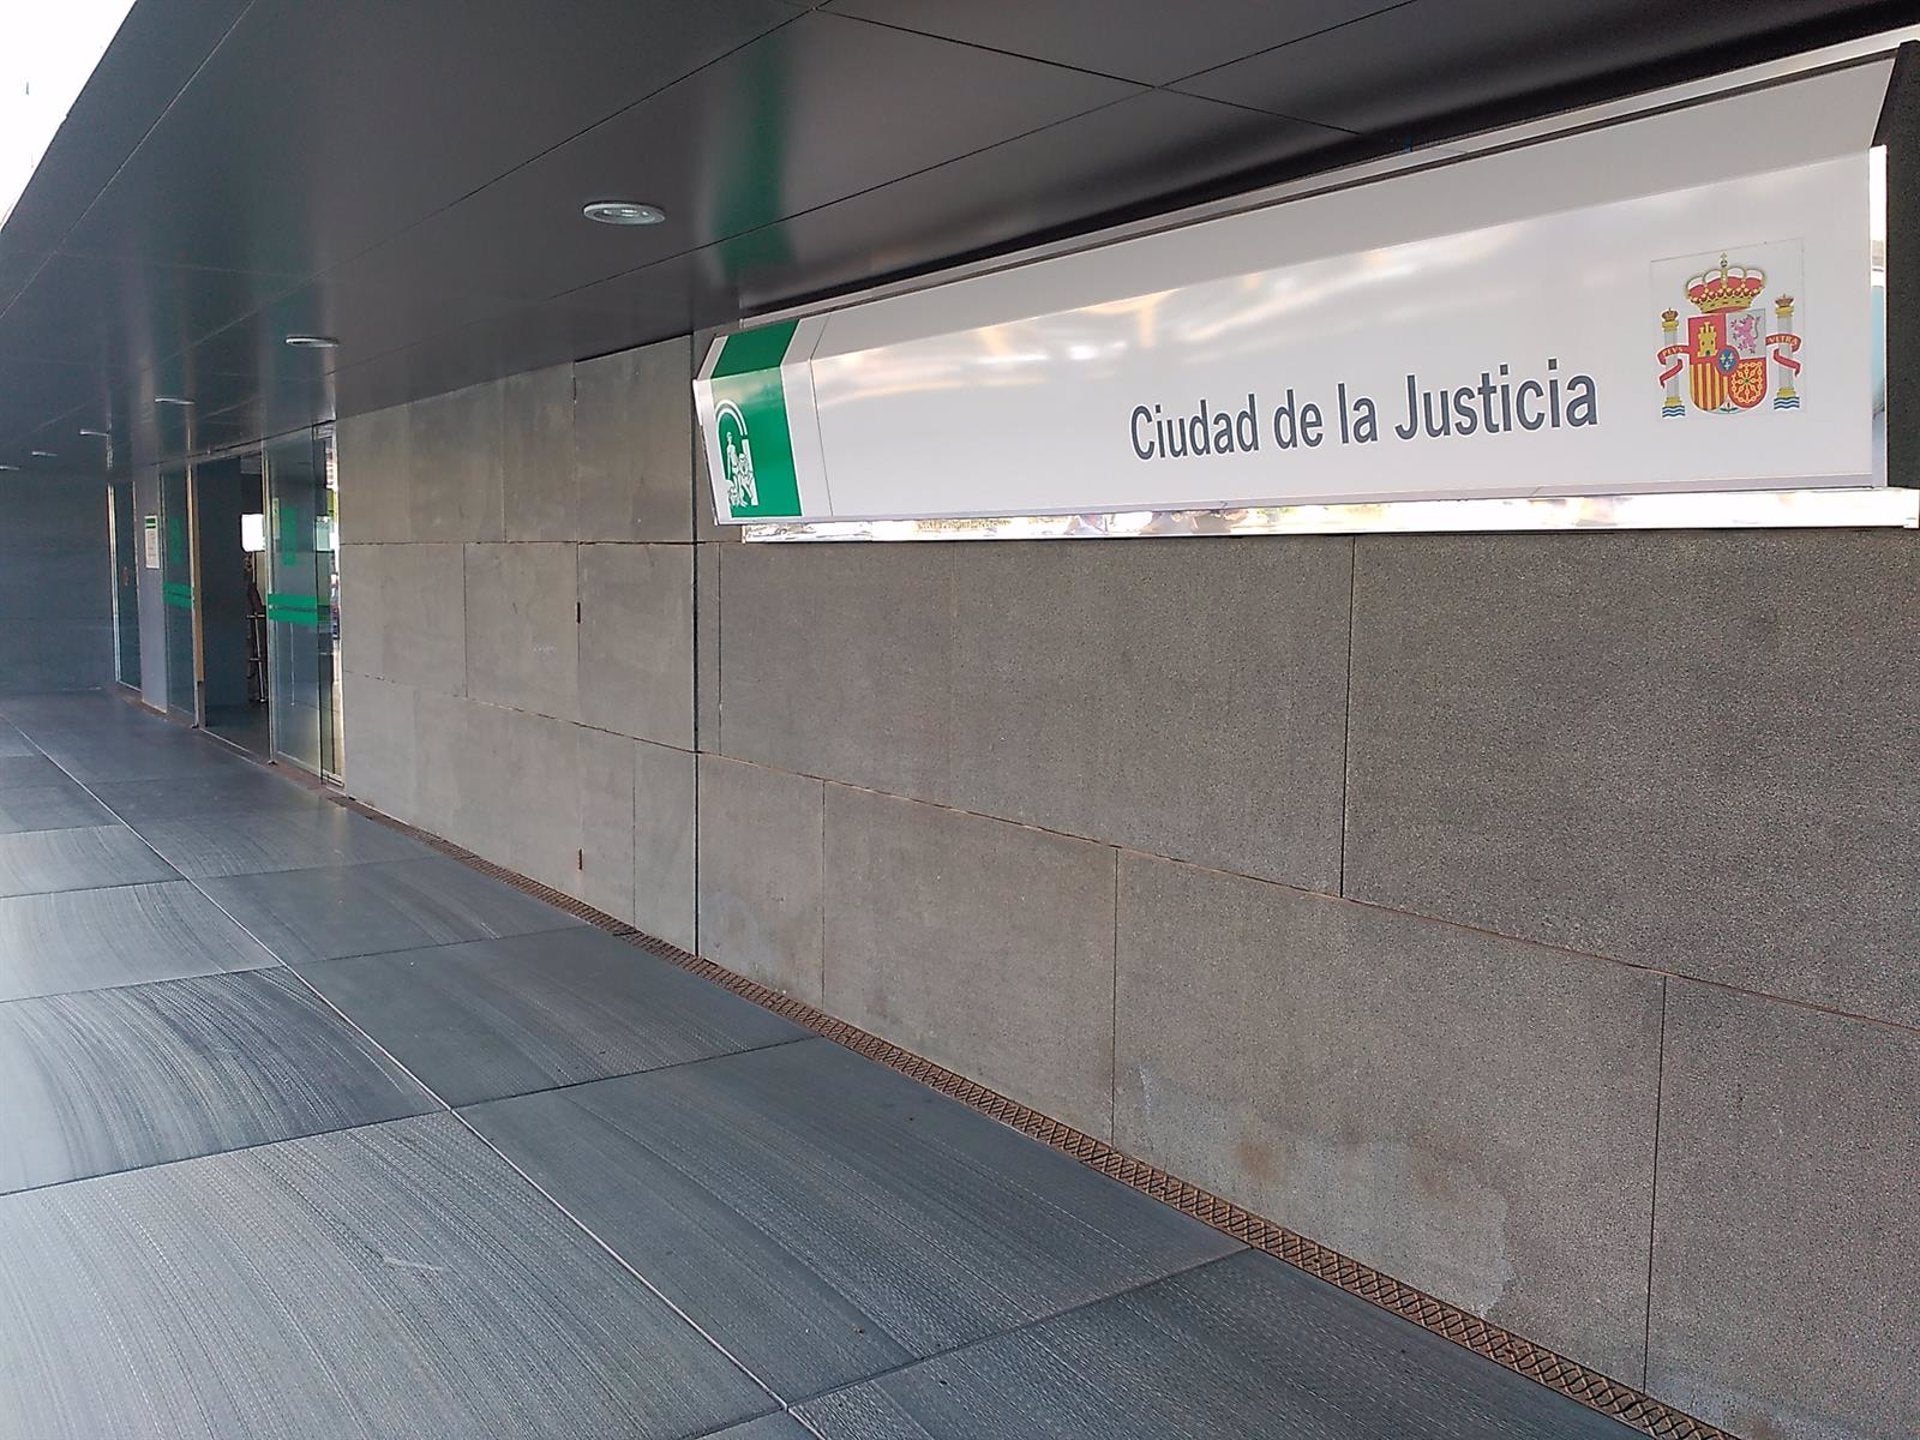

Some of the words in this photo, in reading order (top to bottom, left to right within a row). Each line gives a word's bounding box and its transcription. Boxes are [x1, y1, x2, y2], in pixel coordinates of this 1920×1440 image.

[1131, 393, 1259, 460] Ciudad
[1273, 389, 1323, 449] de
[1338, 383, 1378, 444] la
[1394, 358, 1598, 440] Justicia
